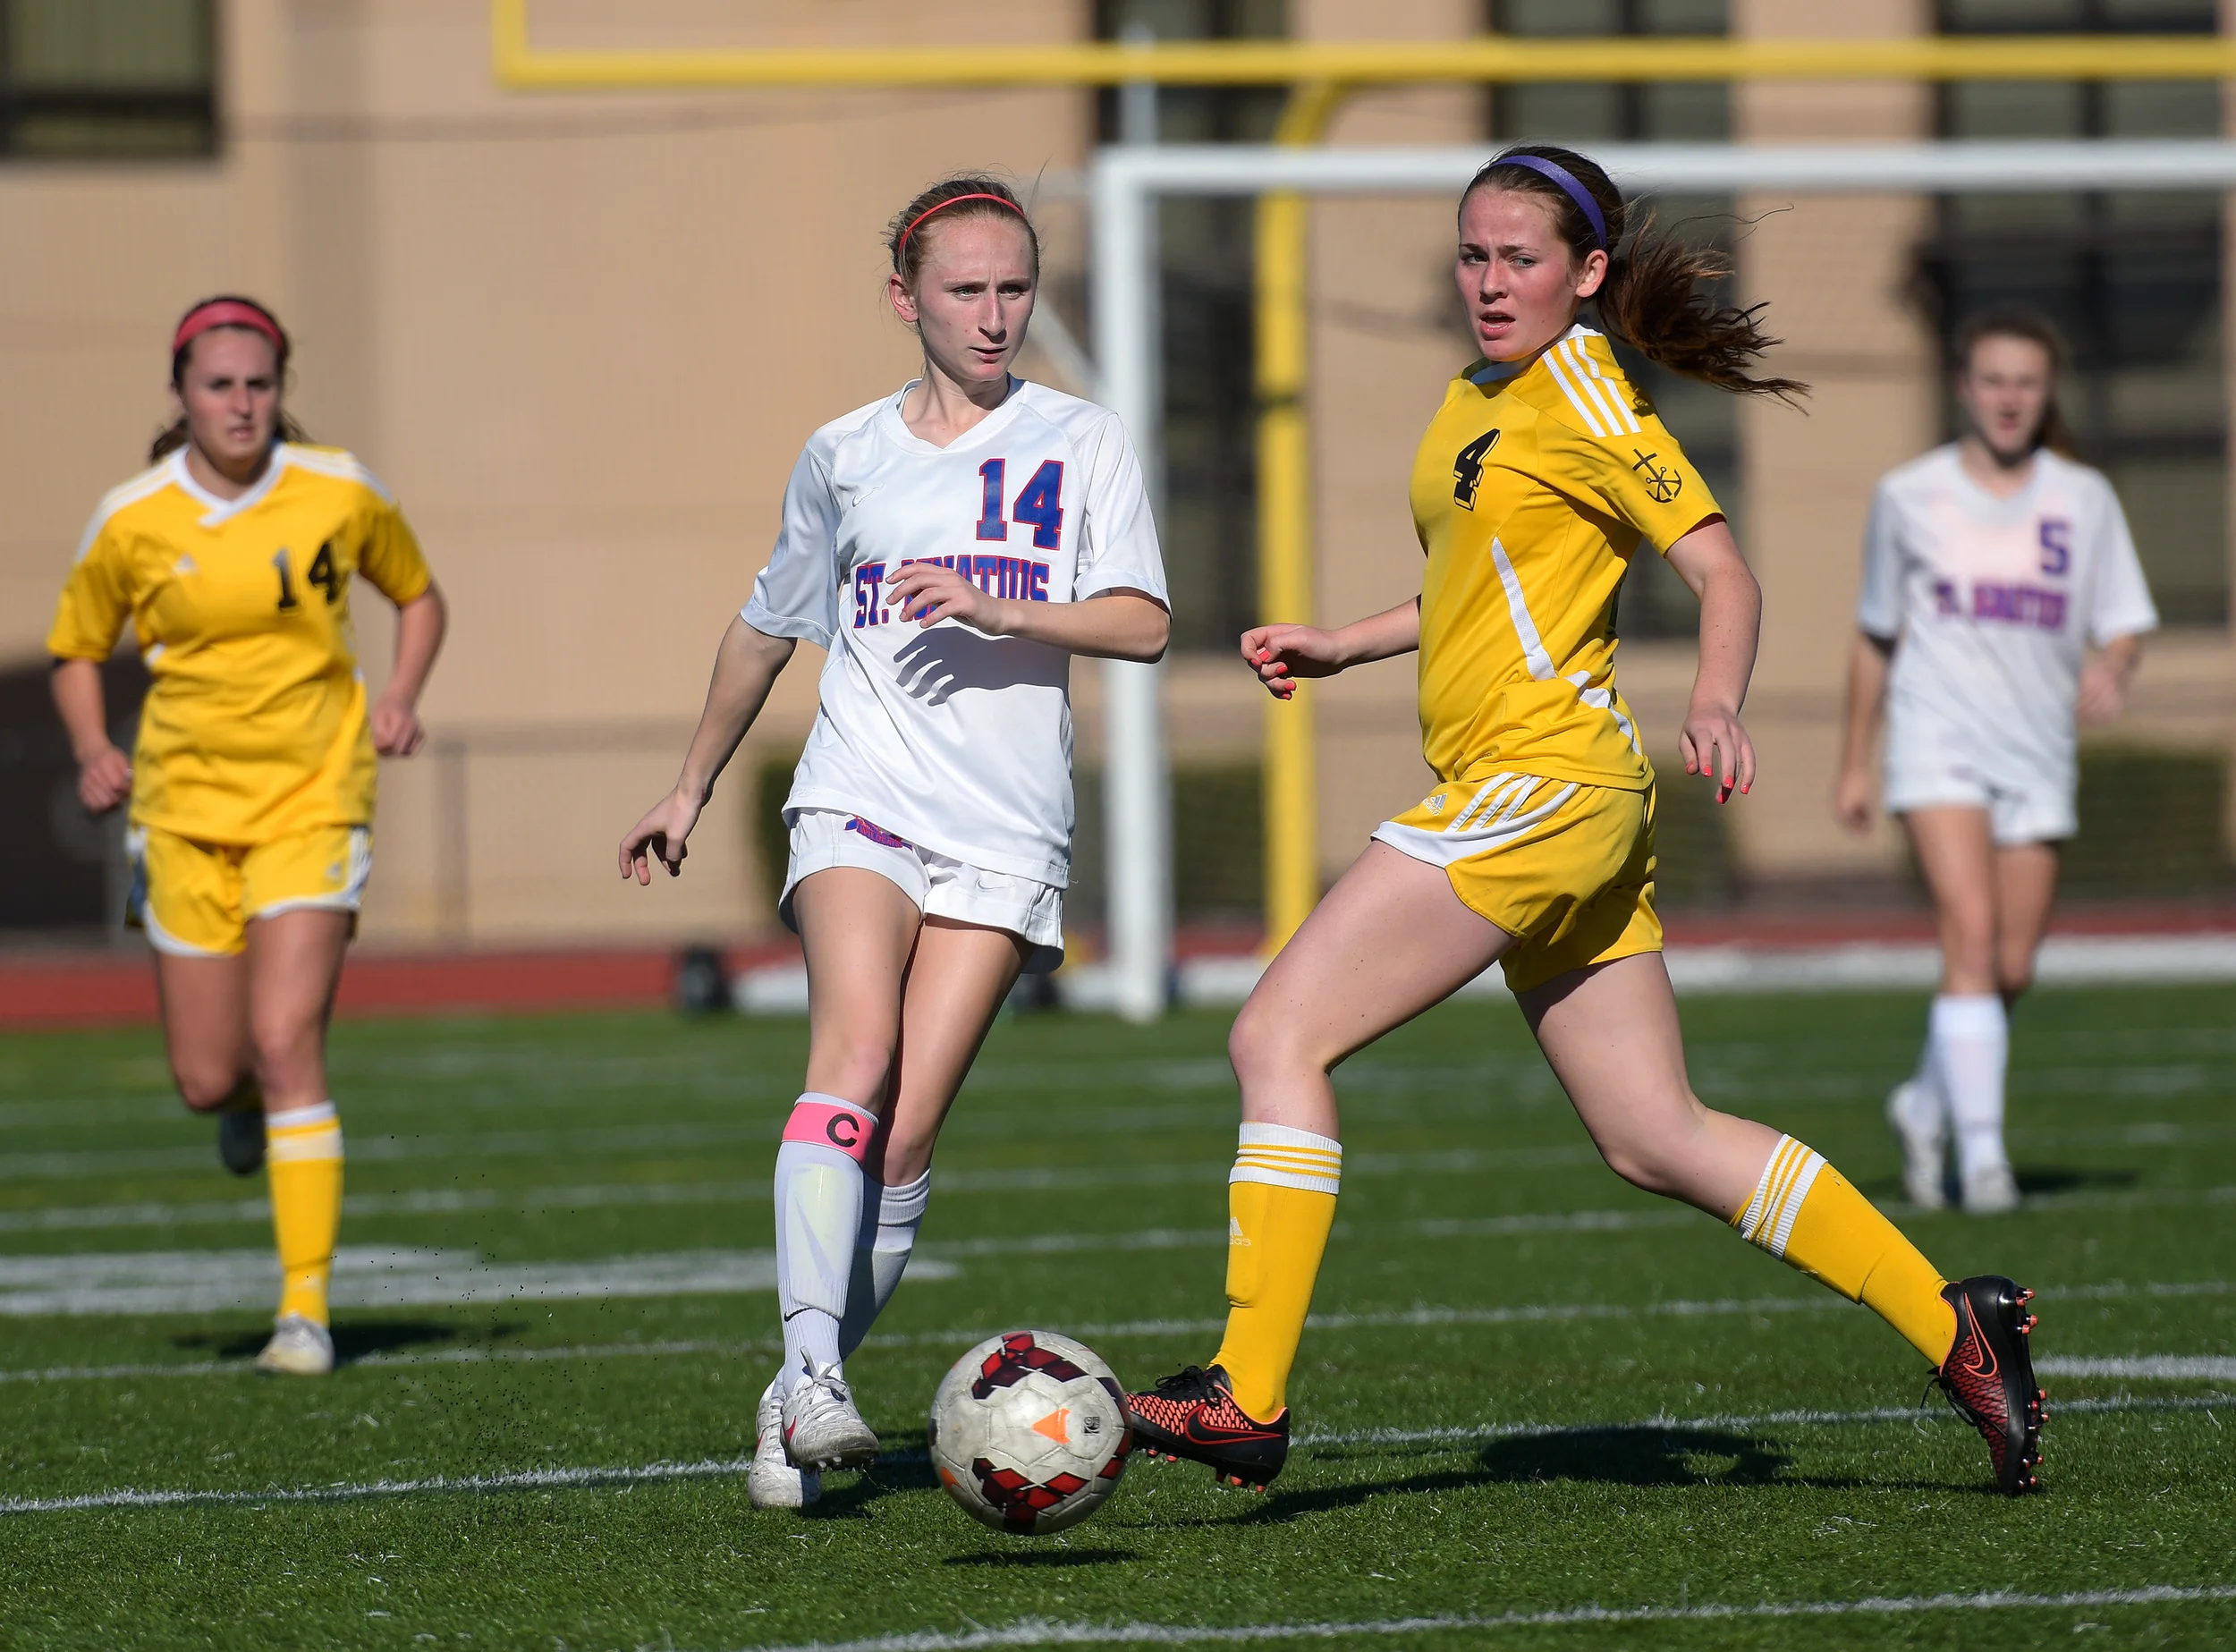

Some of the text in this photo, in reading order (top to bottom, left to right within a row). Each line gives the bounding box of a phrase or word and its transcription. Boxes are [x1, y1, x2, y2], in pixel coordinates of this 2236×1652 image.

[976, 457, 1064, 551] 14
[1453, 428, 1501, 512] 4
[271, 540, 343, 612] 14
[2038, 519, 2071, 575] 5
[853, 563, 890, 629] ST.
[826, 1112, 860, 1148] C
